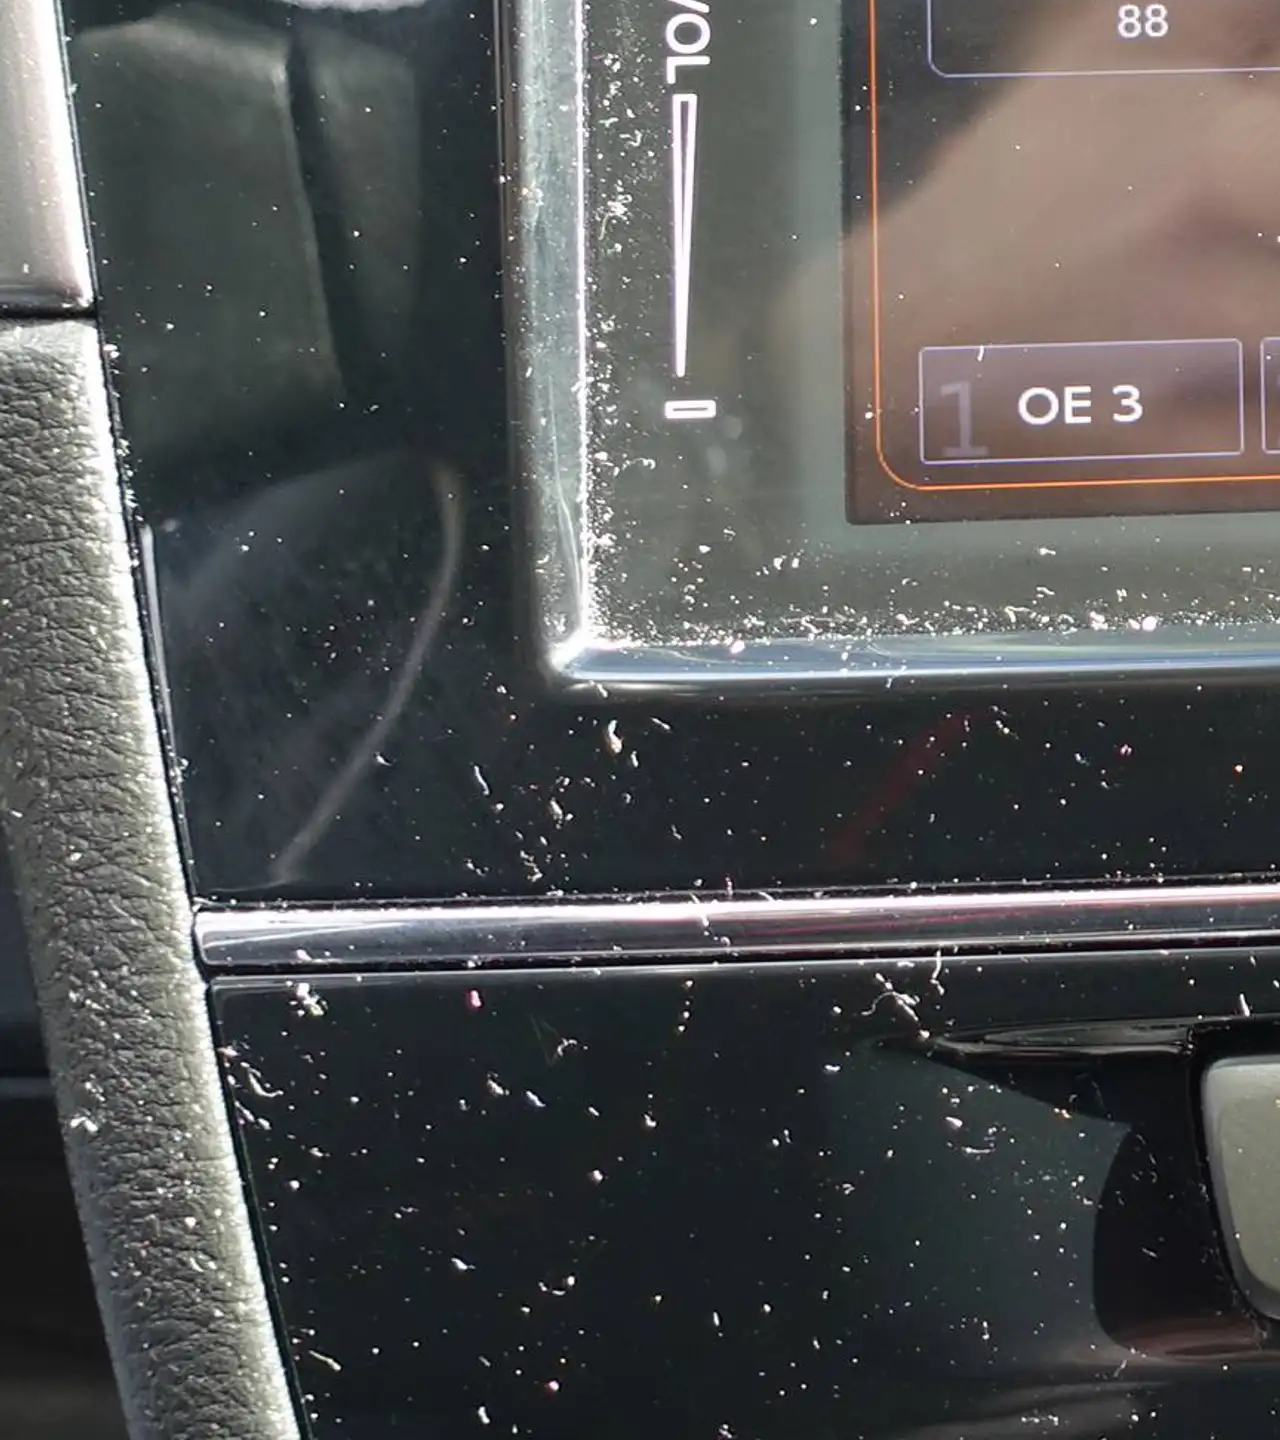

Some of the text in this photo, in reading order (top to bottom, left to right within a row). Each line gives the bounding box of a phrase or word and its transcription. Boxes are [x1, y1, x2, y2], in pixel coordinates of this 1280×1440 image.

[1117, 4, 1169, 38] 88
[940, 382, 990, 458] 1
[1018, 384, 1144, 426] OE 3
